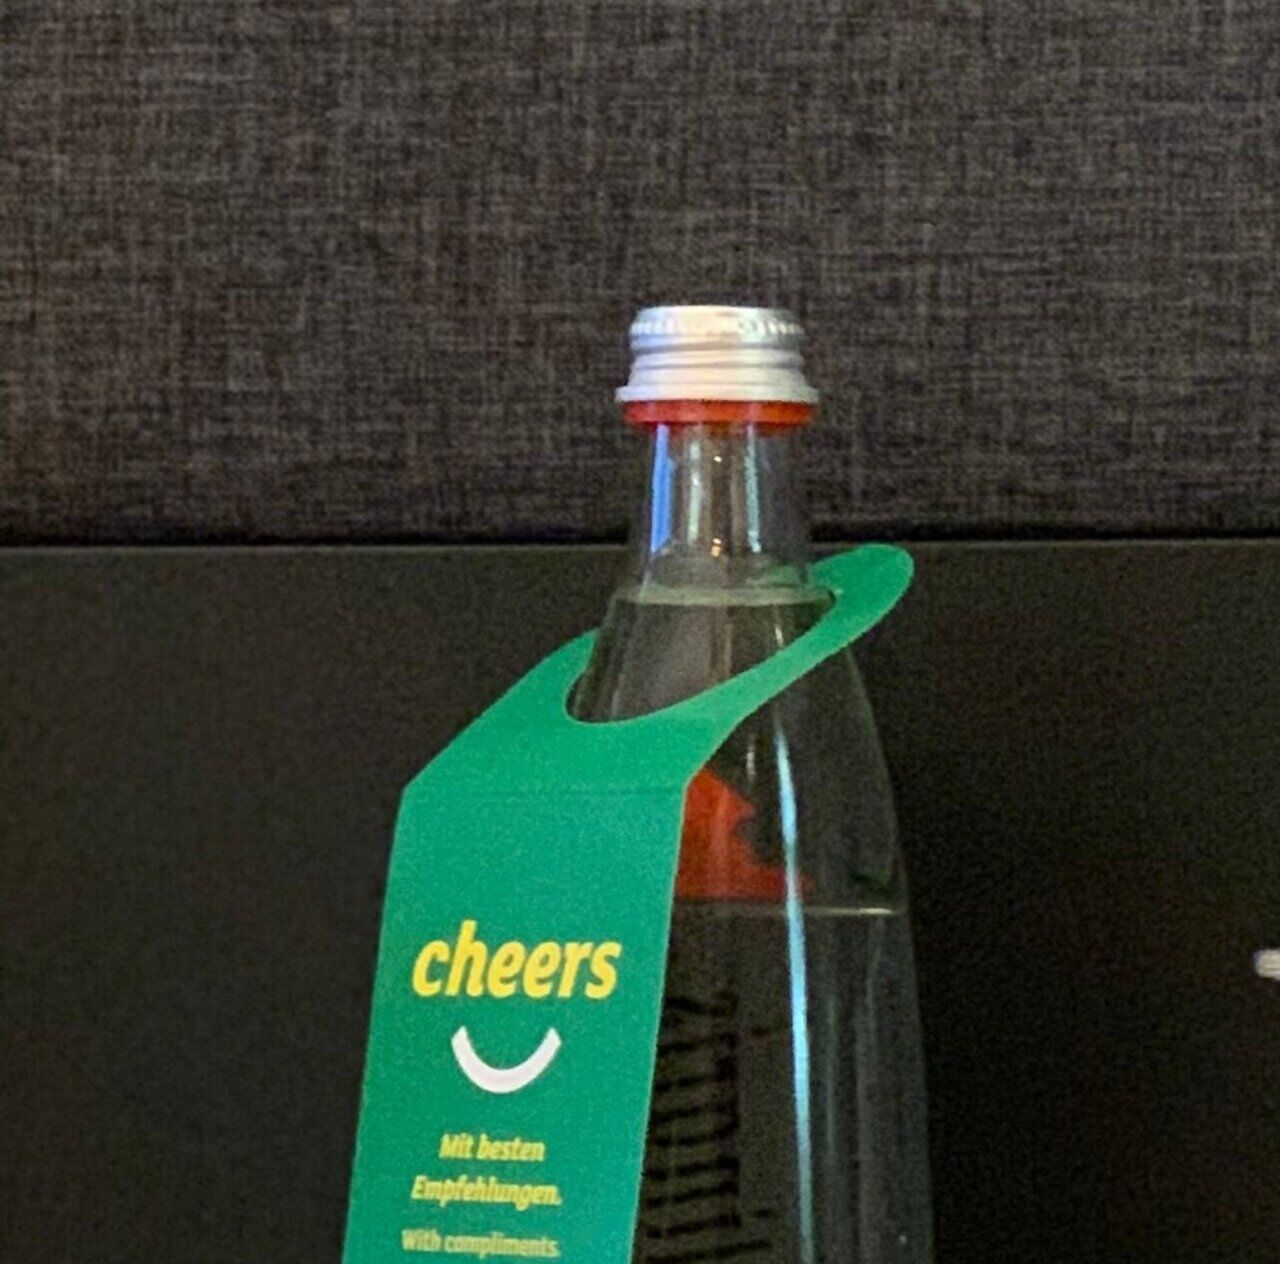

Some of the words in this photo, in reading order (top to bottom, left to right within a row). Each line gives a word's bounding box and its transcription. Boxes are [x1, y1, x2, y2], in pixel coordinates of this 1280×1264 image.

[412, 919, 622, 998] cheers
[438, 1132, 474, 1159] Mit
[476, 1132, 546, 1162] besten
[410, 1173, 563, 1211] Empfehlungen.
[401, 1228, 442, 1252] With
